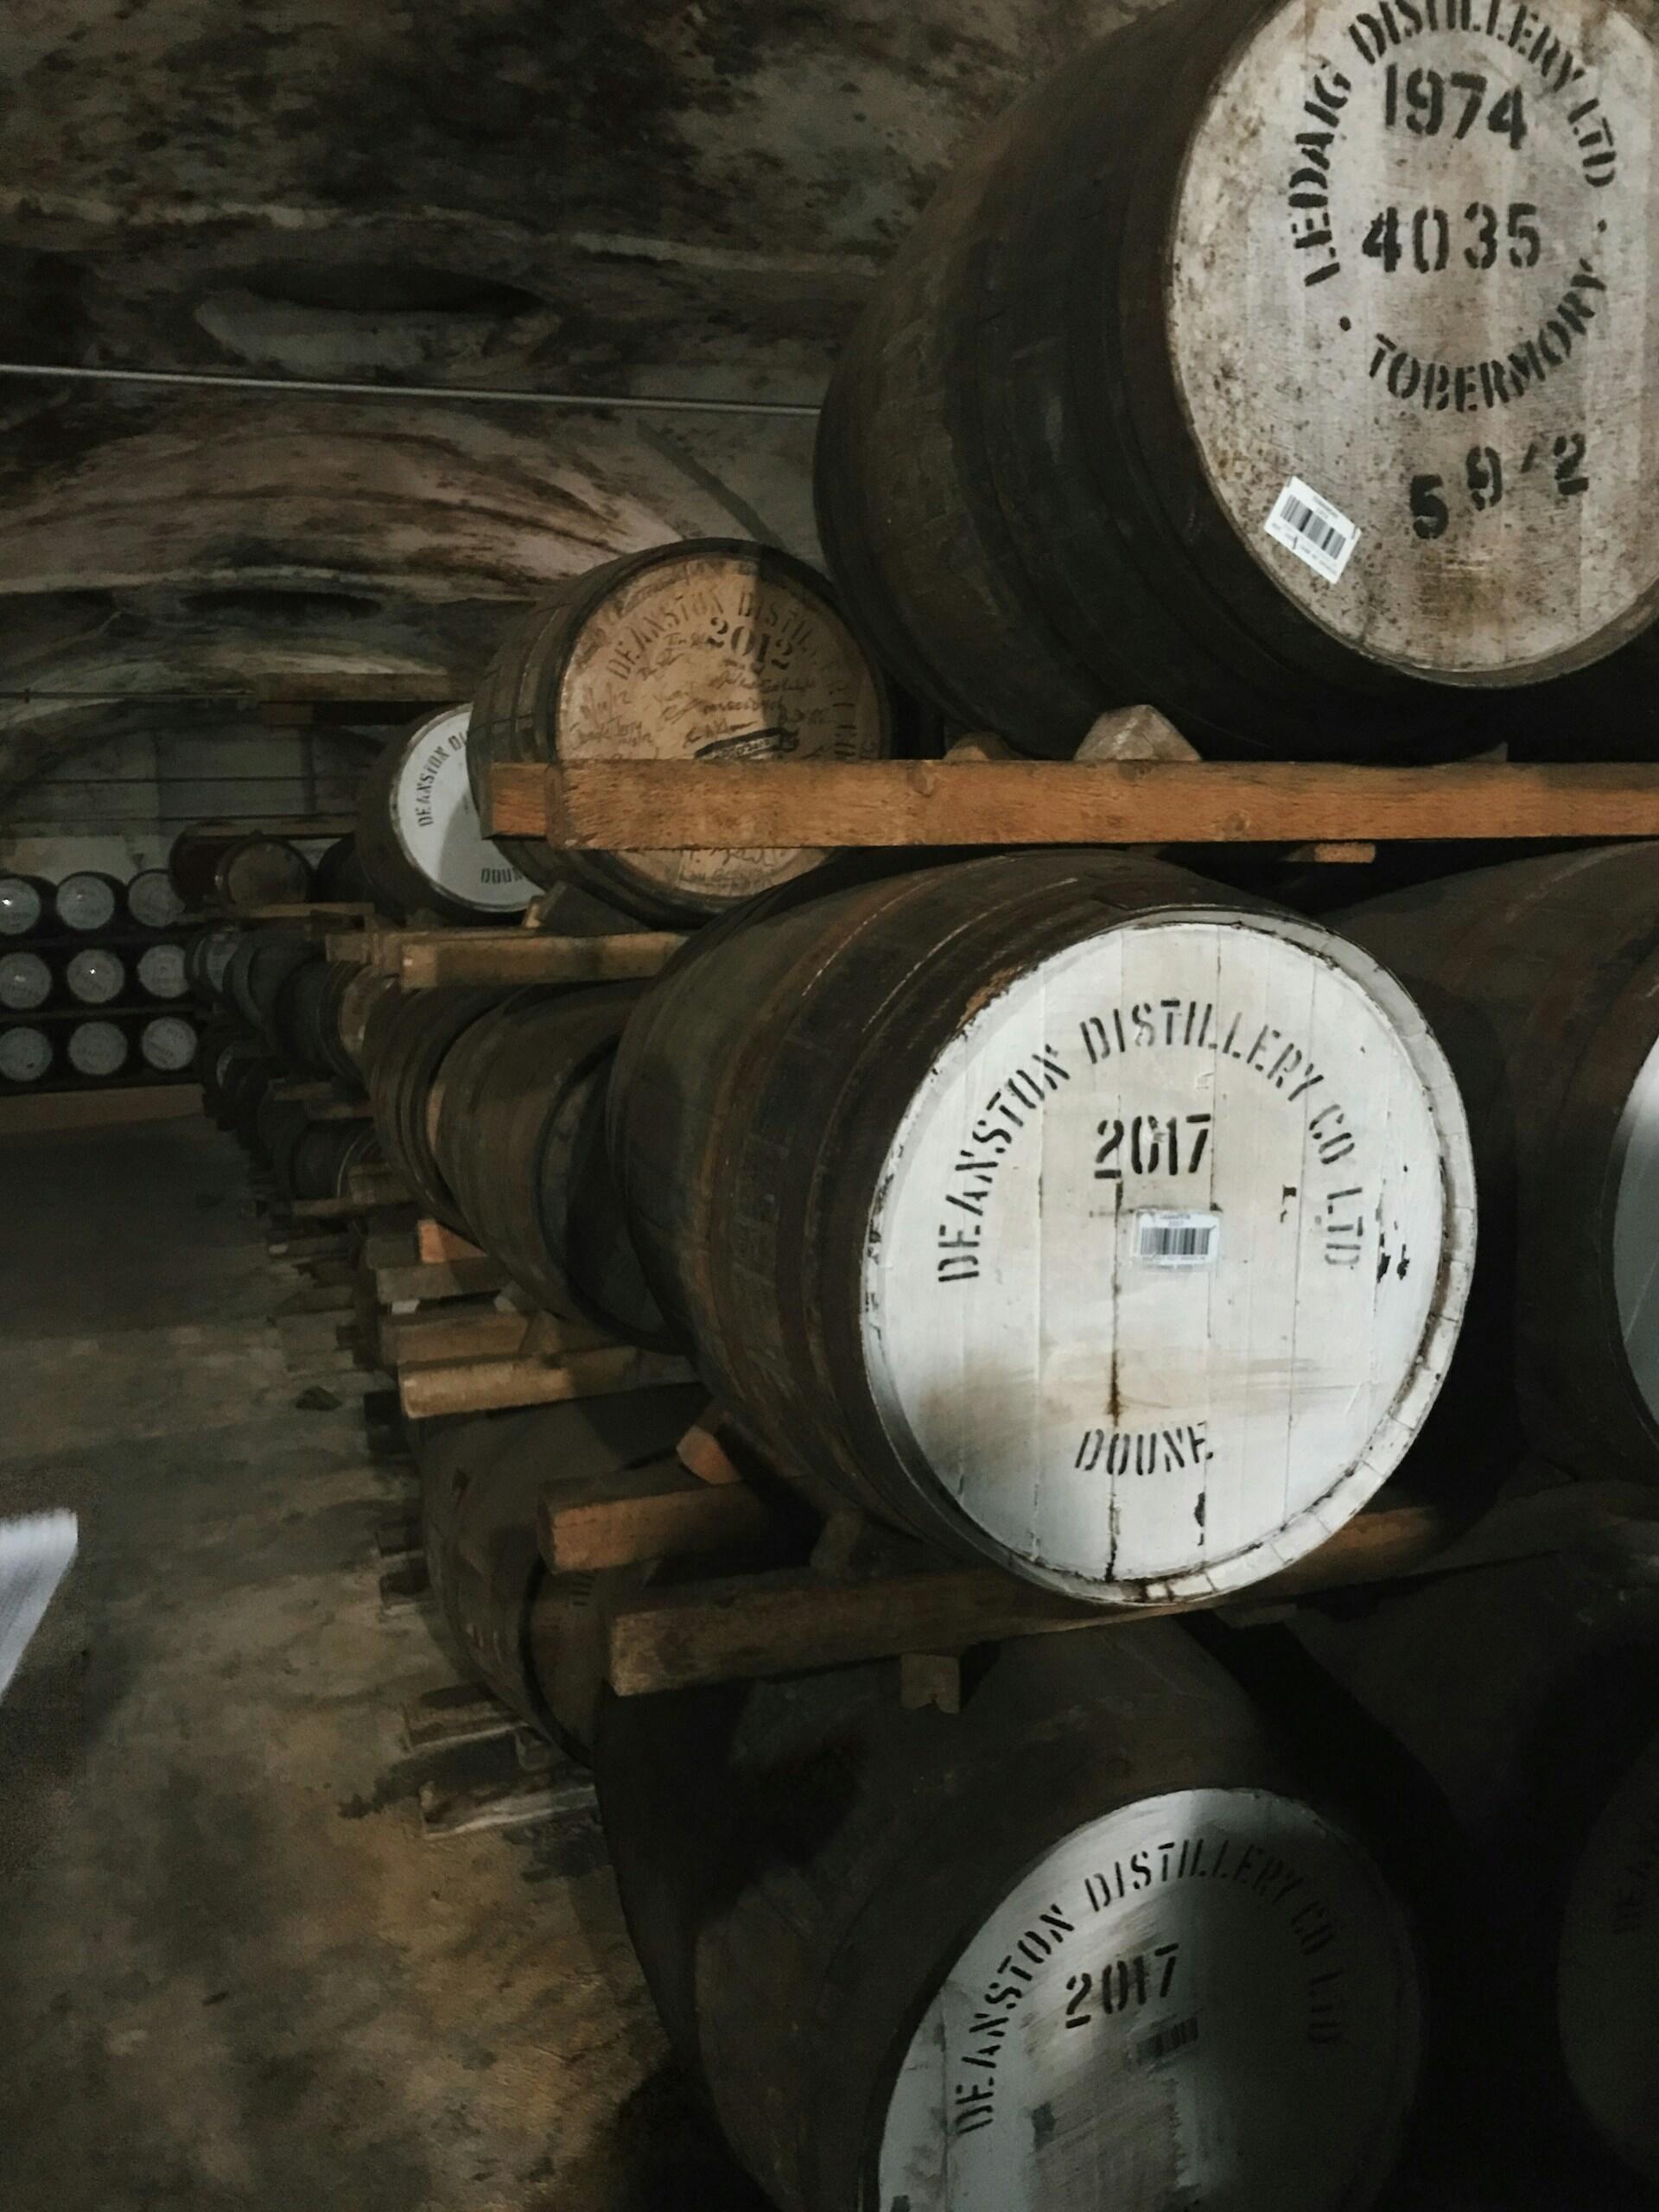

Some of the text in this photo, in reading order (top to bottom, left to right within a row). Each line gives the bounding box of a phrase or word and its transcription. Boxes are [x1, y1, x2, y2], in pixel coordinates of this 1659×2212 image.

[1288, 0, 1617, 287] LEDAIG DISTILLERY LTD
[1385, 64, 1528, 150] 1974
[1362, 201, 1541, 273] 4035
[1370, 258, 1606, 412] TOBERMORY
[607, 585, 724, 680] DEANSTON
[706, 616, 793, 671] 2012
[416, 745, 450, 827] DEANSTON
[938, 998, 1363, 1282] DEANSTON DISTILLERY CO LTD
[1094, 1114, 1212, 1179] 2017
[1074, 1420, 1214, 1477] DOUNE
[956, 1904, 1074, 2136] DEANSTON
[1084, 1838, 1304, 1912] DISTILLERY
[1065, 1942, 1179, 2029] 2017
